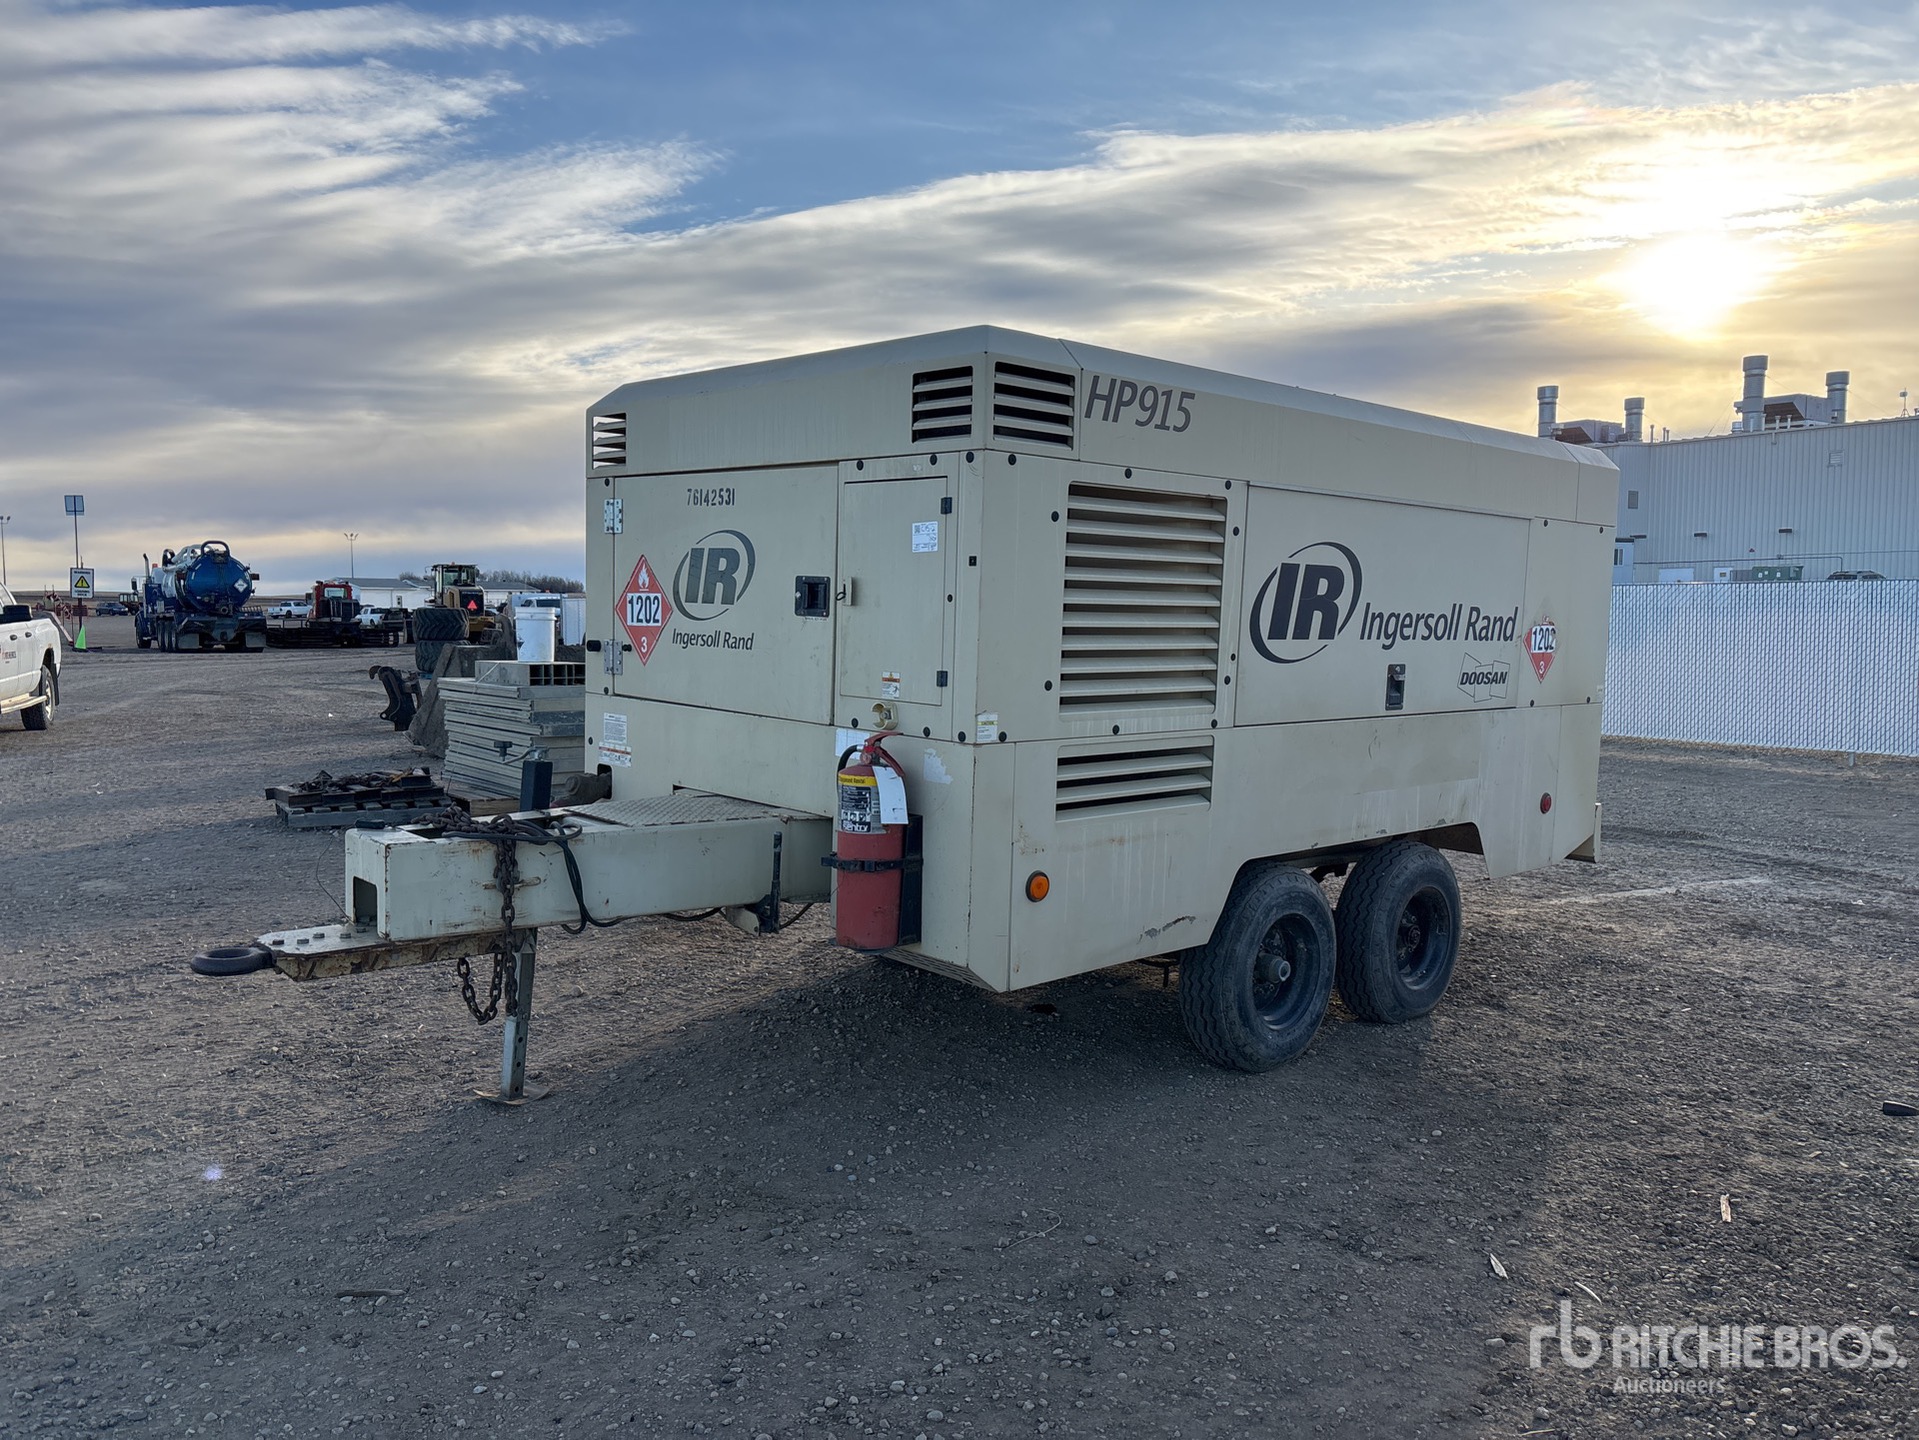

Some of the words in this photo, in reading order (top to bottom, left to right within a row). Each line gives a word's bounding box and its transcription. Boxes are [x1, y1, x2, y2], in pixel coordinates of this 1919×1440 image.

[1084, 375, 1195, 432] HP915
[687, 487, 735, 507] 76142531
[685, 547, 740, 605] IR
[628, 595, 660, 624] 1202
[1267, 562, 1345, 640] IR
[1359, 602, 1463, 650] Ingersoll
[1464, 606, 1519, 642] Rand
[640, 636, 648, 653] 3
[672, 628, 721, 650] Ingersoll
[722, 632, 754, 651] Rand
[1460, 671, 1508, 686] DOOSAN
[1539, 660, 1545, 675] 3
